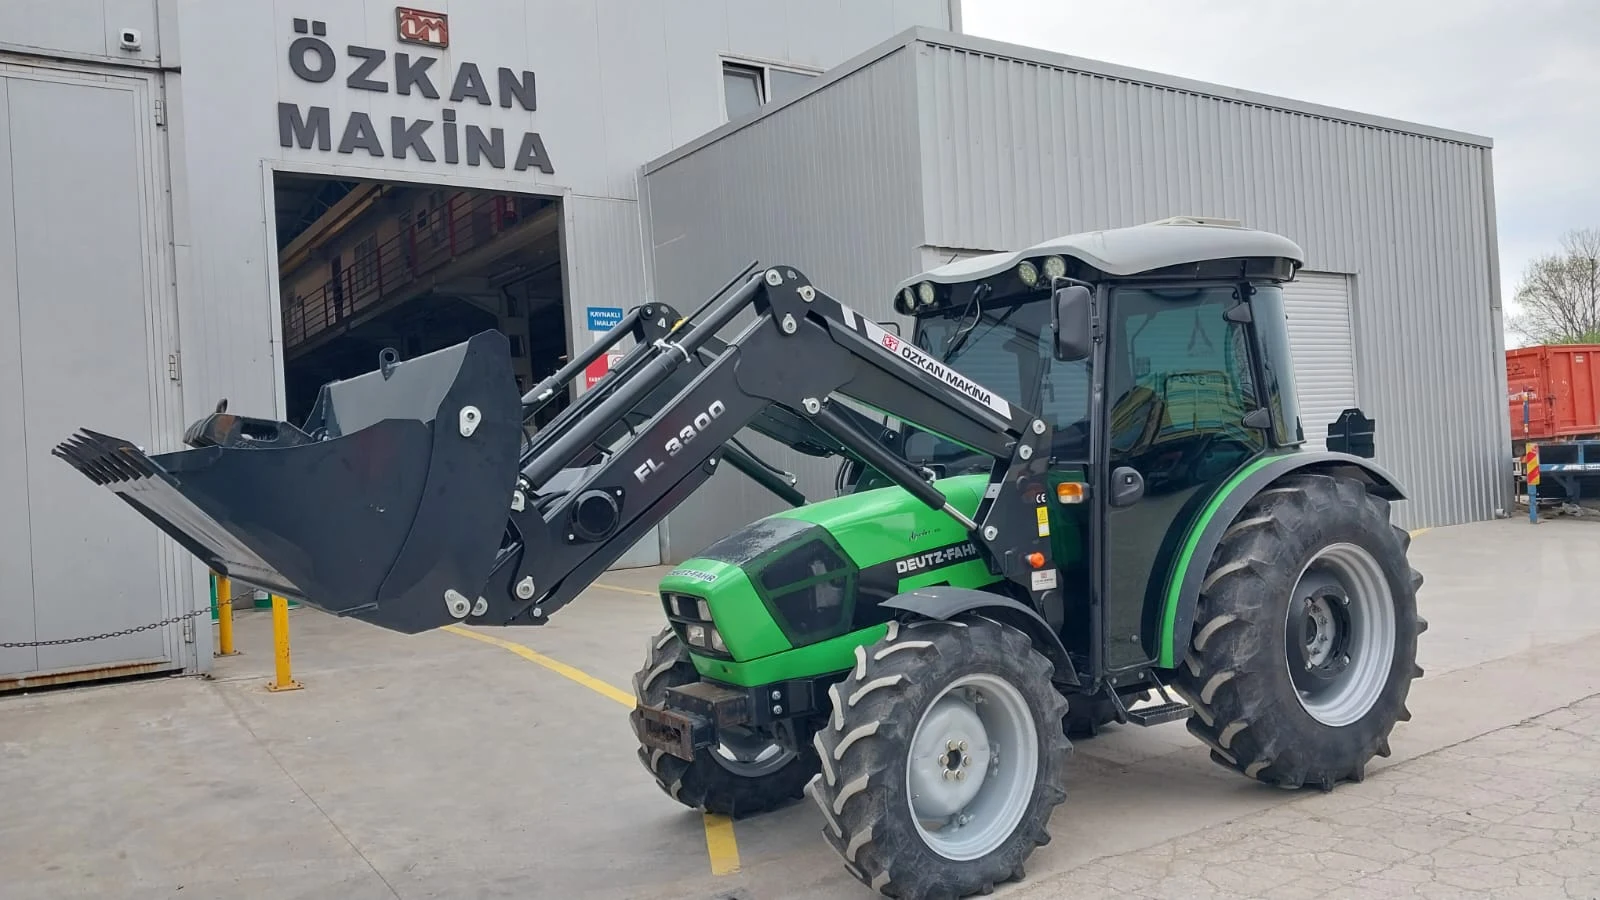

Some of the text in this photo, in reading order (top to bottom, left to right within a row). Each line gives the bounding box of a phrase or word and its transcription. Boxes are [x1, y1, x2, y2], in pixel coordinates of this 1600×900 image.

[289, 18, 537, 111] ÖZKAN
[278, 101, 555, 174] MAKİNA
[901, 347, 991, 405] ÖZKAN MAKİNA
[633, 400, 726, 484] FL 3300
